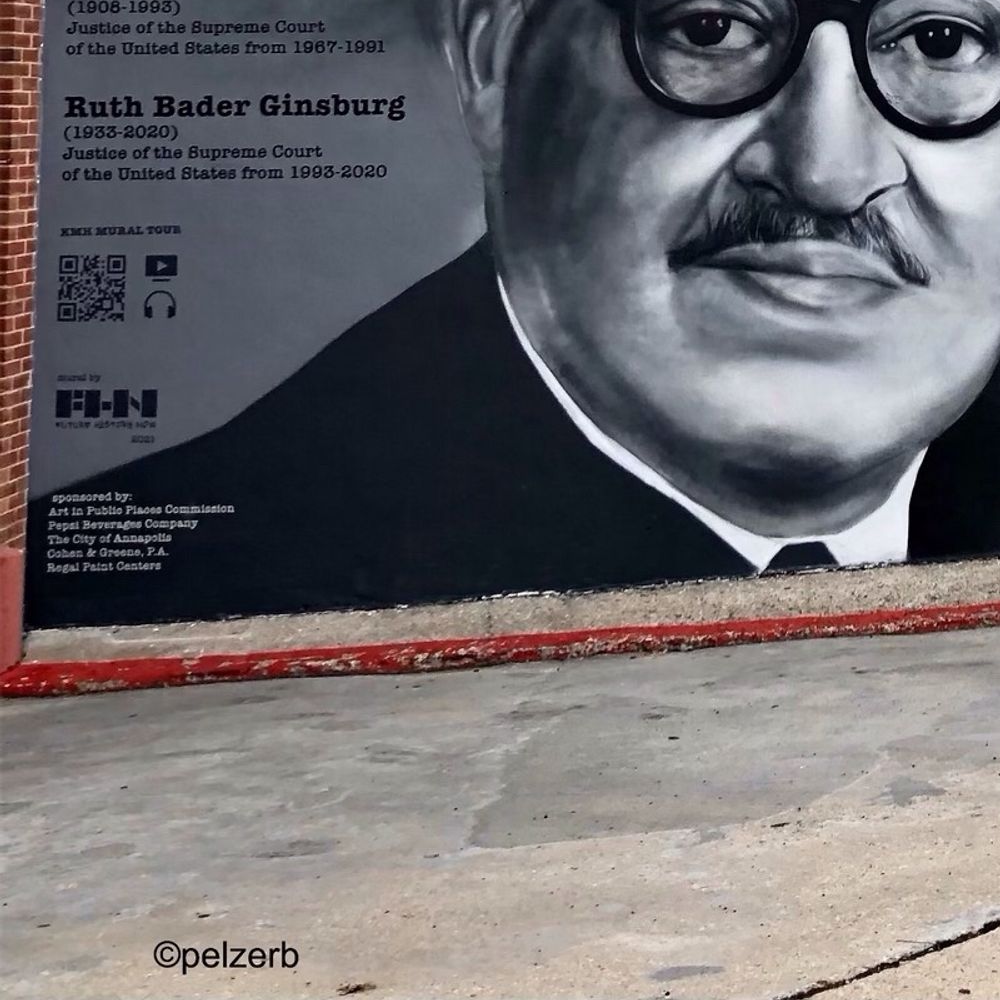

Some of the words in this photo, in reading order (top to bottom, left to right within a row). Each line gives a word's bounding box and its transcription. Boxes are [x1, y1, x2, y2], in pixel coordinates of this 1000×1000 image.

[67, 0, 181, 15] (1908-1993)
[66, 21, 130, 34] Justice
[136, 21, 155, 34] of
[158, 21, 186, 34] the
[191, 21, 269, 37] Supreme
[275, 20, 325, 33] Court
[66, 42, 86, 55] of
[88, 42, 116, 55] the
[122, 42, 179, 55] United
[185, 42, 240, 55] States
[245, 41, 286, 54] from
[294, 41, 385, 54] 1967-1991
[64, 97, 144, 118] Ruth
[153, 96, 251, 117] Bader
[260, 94, 405, 120] Ginsburg
[63, 125, 179, 140] (1933-2020)
[63, 147, 127, 160] Justice
[133, 147, 152, 159] of
[155, 147, 183, 159] the
[188, 146, 267, 161] Supreme
[272, 146, 322, 158] Court
[62, 168, 82, 181] of
[84, 168, 112, 180] the
[118, 167, 176, 180] United
[181, 167, 236, 180] States
[241, 166, 283, 179] from
[290, 165, 387, 179] 1993-2020
[95, 226, 144, 235] MURAL
[146, 225, 181, 234] TOUR
[89, 374, 101, 382] by
[52, 492, 112, 503] sponsored
[115, 492, 132, 502] by:
[48, 507, 69, 516] Art
[72, 507, 84, 515] in
[87, 506, 123, 515] Public
[126, 505, 162, 515] Places
[165, 504, 235, 514] Commission
[48, 521, 79, 531] Pepsi
[82, 520, 142, 531] Beverages
[145, 519, 198, 529] Company
[48, 535, 69, 545] The
[72, 534, 97, 545] City
[99, 534, 111, 544] of
[113, 533, 172, 544] Annapolis
[47, 549, 84, 558] Cohen
[87, 549, 97, 558] &
[100, 548, 144, 559] Greene,
[147, 547, 169, 556] P.A.
[47, 563, 80, 573] Regal
[82, 562, 114, 572] Paint
[117, 561, 161, 571] Centers
